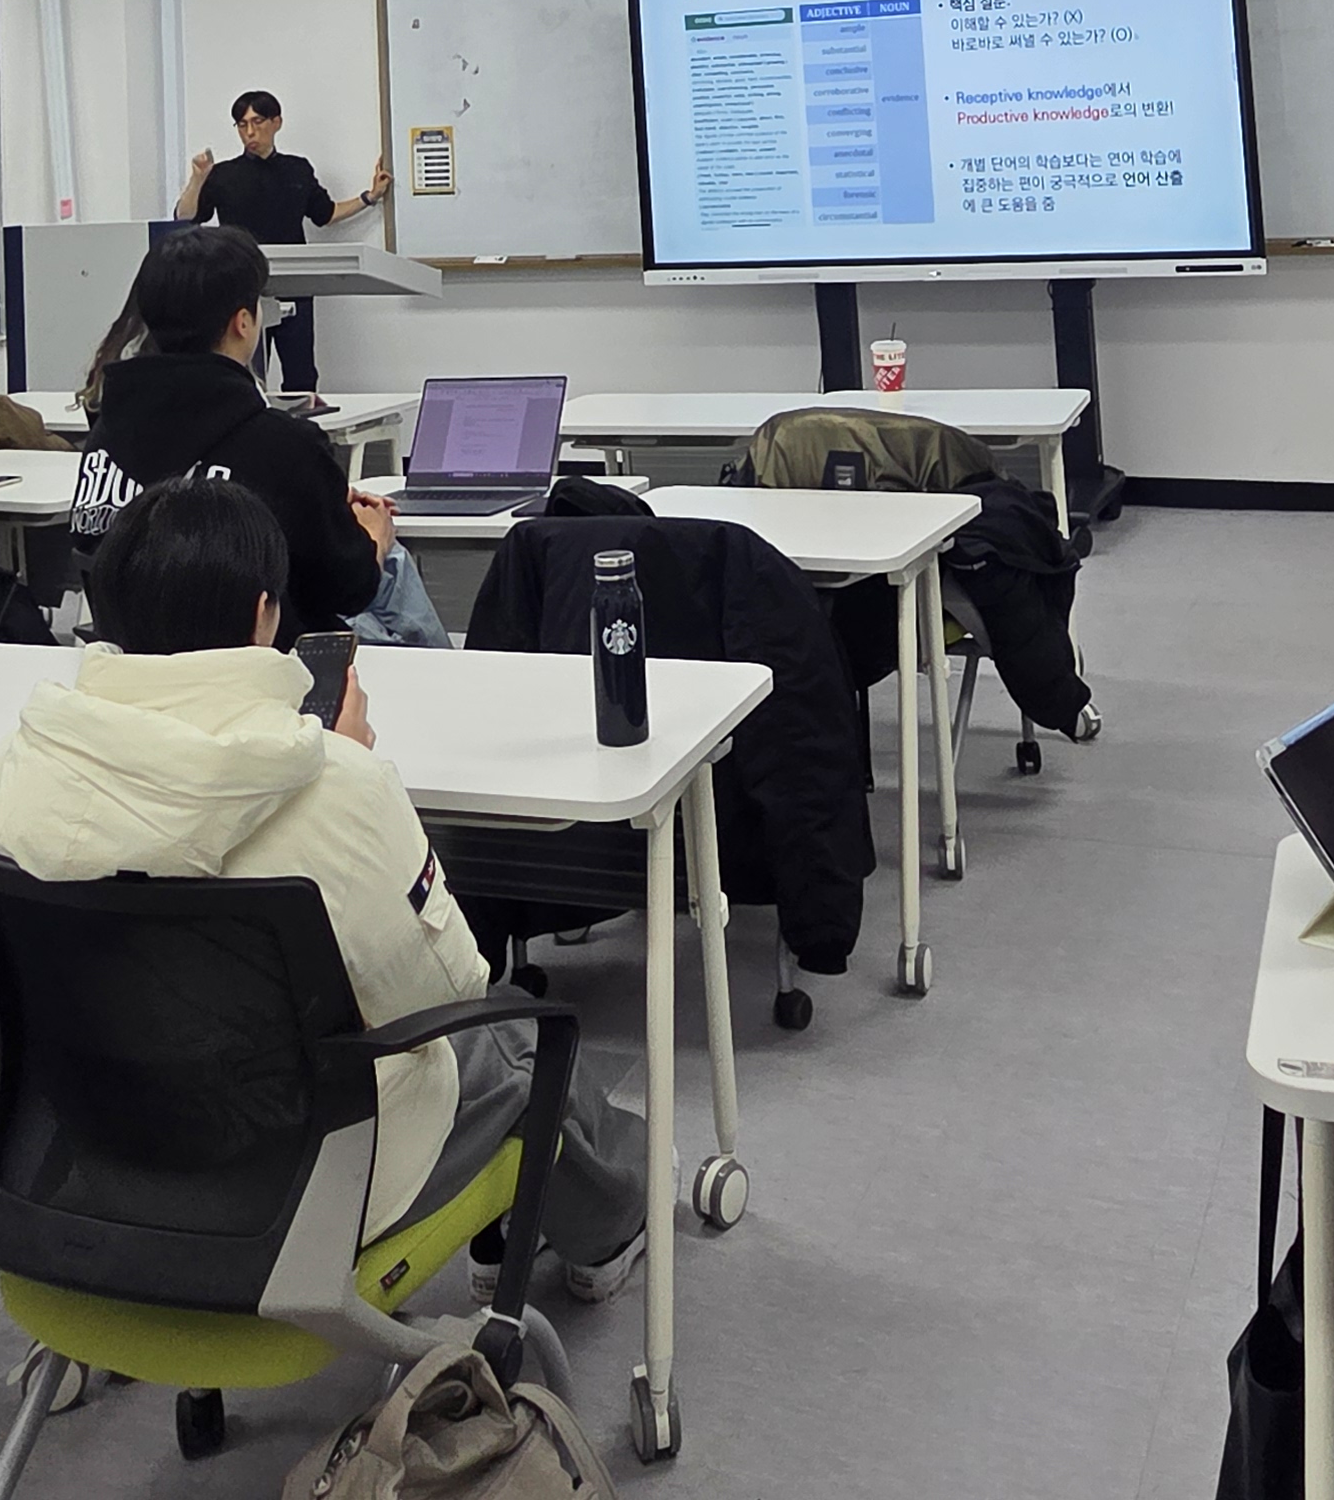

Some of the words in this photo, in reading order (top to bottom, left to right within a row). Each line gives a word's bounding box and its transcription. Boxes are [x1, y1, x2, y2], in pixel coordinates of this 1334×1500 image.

[806, 4, 862, 19] ADJECTIVE
[879, 1, 910, 14] NOUN
[950, 15, 990, 32] 이해할
[994, 15, 1007, 30] 수
[1011, 11, 1060, 29] 있는가?
[1063, 8, 1084, 25] (X)
[951, 35, 1005, 52] 바로바로
[1008, 33, 1035, 49] 써낼
[1040, 32, 1054, 47] 수
[1058, 28, 1107, 46] 있는가?
[821, 44, 867, 56] substantial
[825, 65, 868, 76] conclusive
[813, 86, 869, 98] corroborative
[881, 93, 919, 103] evidence
[956, 90, 1024, 106] Receptive
[1027, 81, 1132, 102] knowledge에서
[827, 106, 871, 117] conflicting
[957, 109, 1029, 125] Productive
[1033, 101, 1137, 122] knowledge로의
[826, 127, 873, 138] converging
[833, 148, 874, 158] anecdotal
[960, 157, 986, 173] 개별
[991, 155, 1031, 172] 단어의
[1035, 152, 1103, 170] 학습보다는
[1107, 151, 1135, 168] 연어
[1140, 148, 1182, 166] 학습에
[835, 168, 875, 179] statistical
[962, 176, 1014, 194] 집중하는
[1018, 175, 1046, 191] 편이
[1049, 172, 1118, 191] 궁극적으로
[843, 189, 876, 199] forensic
[963, 198, 976, 213] 에
[981, 197, 994, 213] 큰
[998, 196, 1037, 212] 도움을
[1042, 195, 1056, 212] 줌
[818, 210, 878, 222] circumstantial
